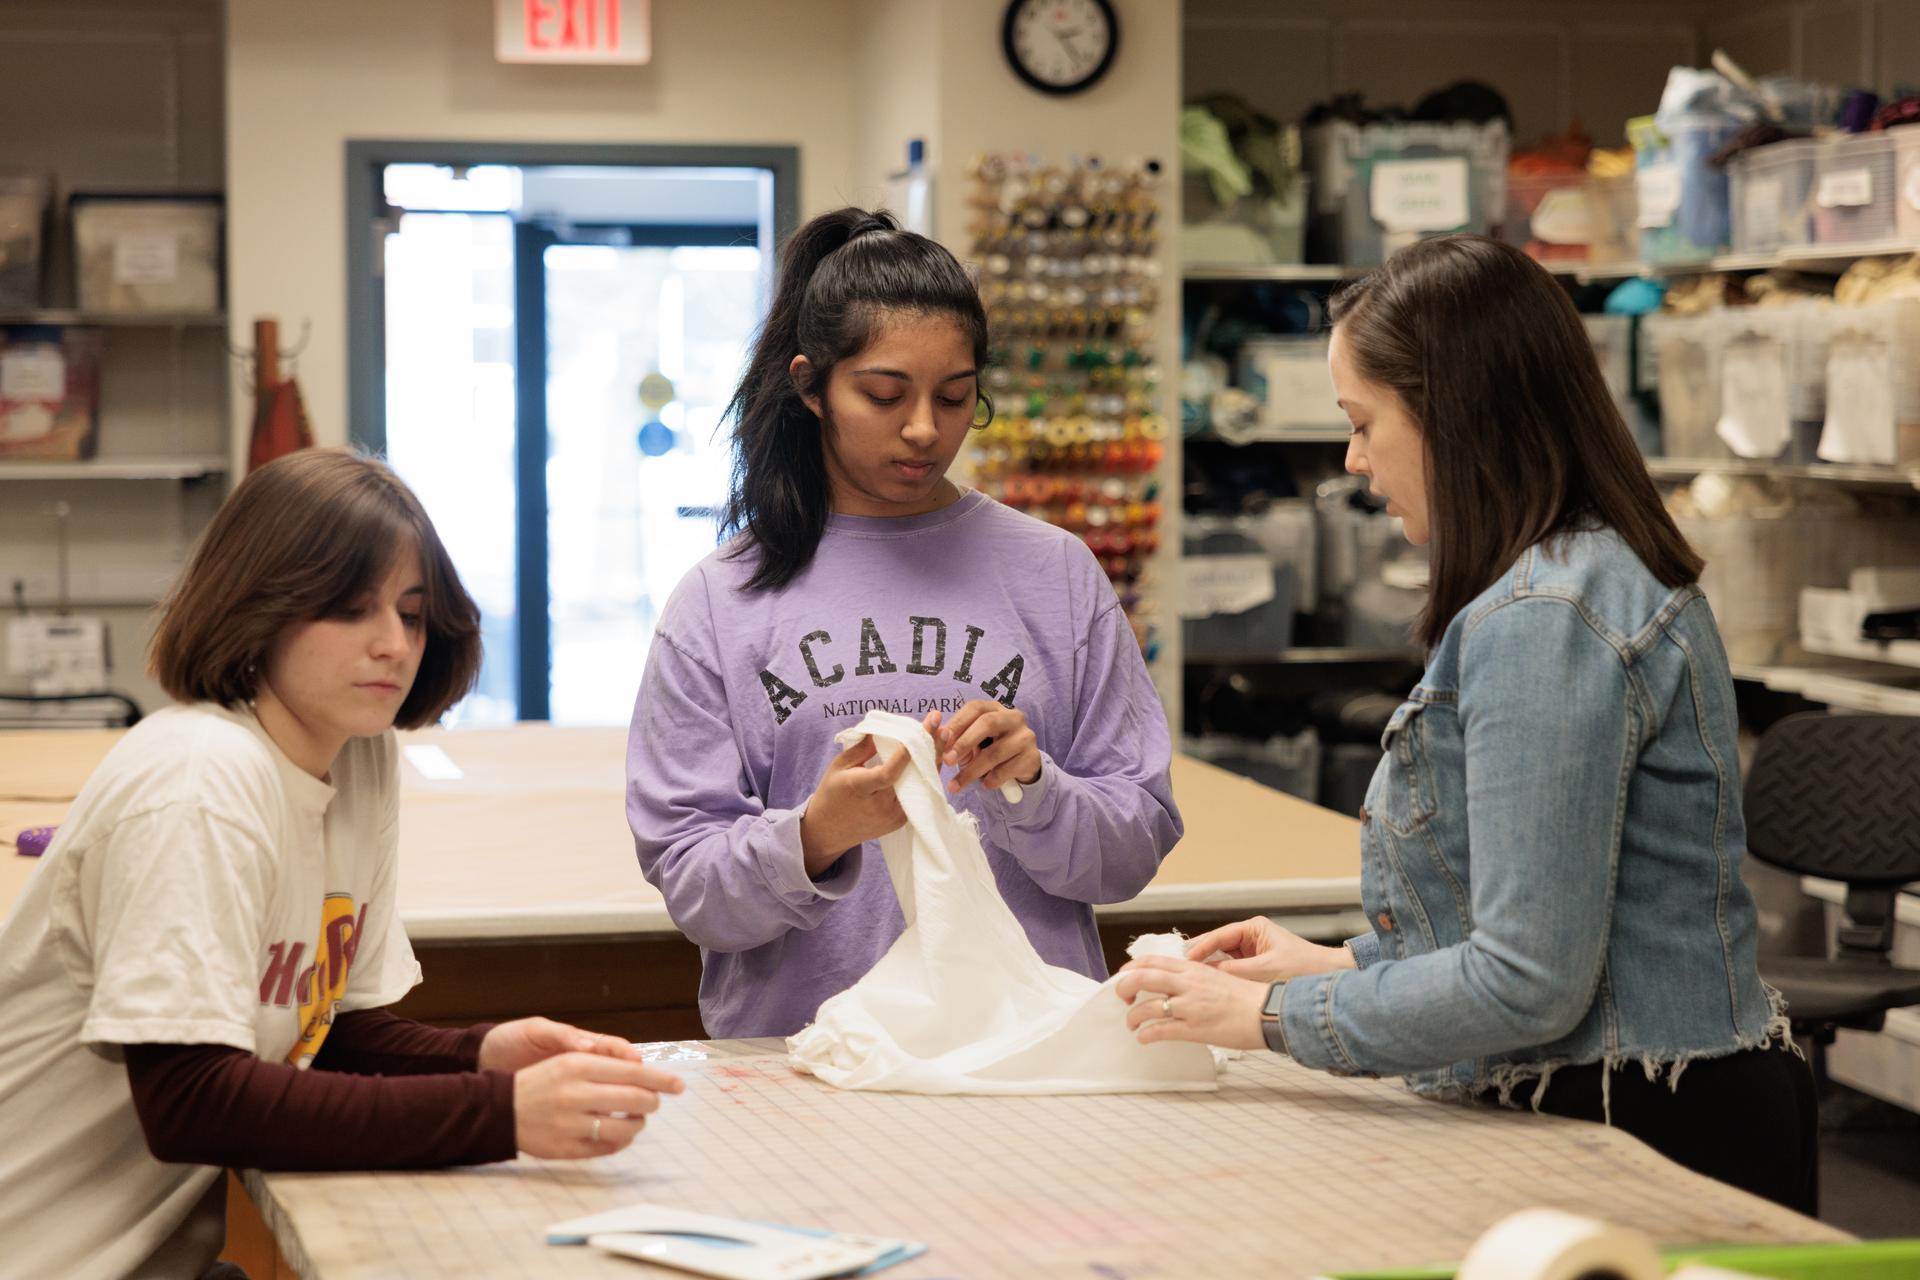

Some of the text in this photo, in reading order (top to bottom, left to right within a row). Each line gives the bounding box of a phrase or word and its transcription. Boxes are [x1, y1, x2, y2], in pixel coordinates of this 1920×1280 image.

[759, 615, 1025, 726] ACADIA
[823, 698, 964, 718] NATIONAL PARK
